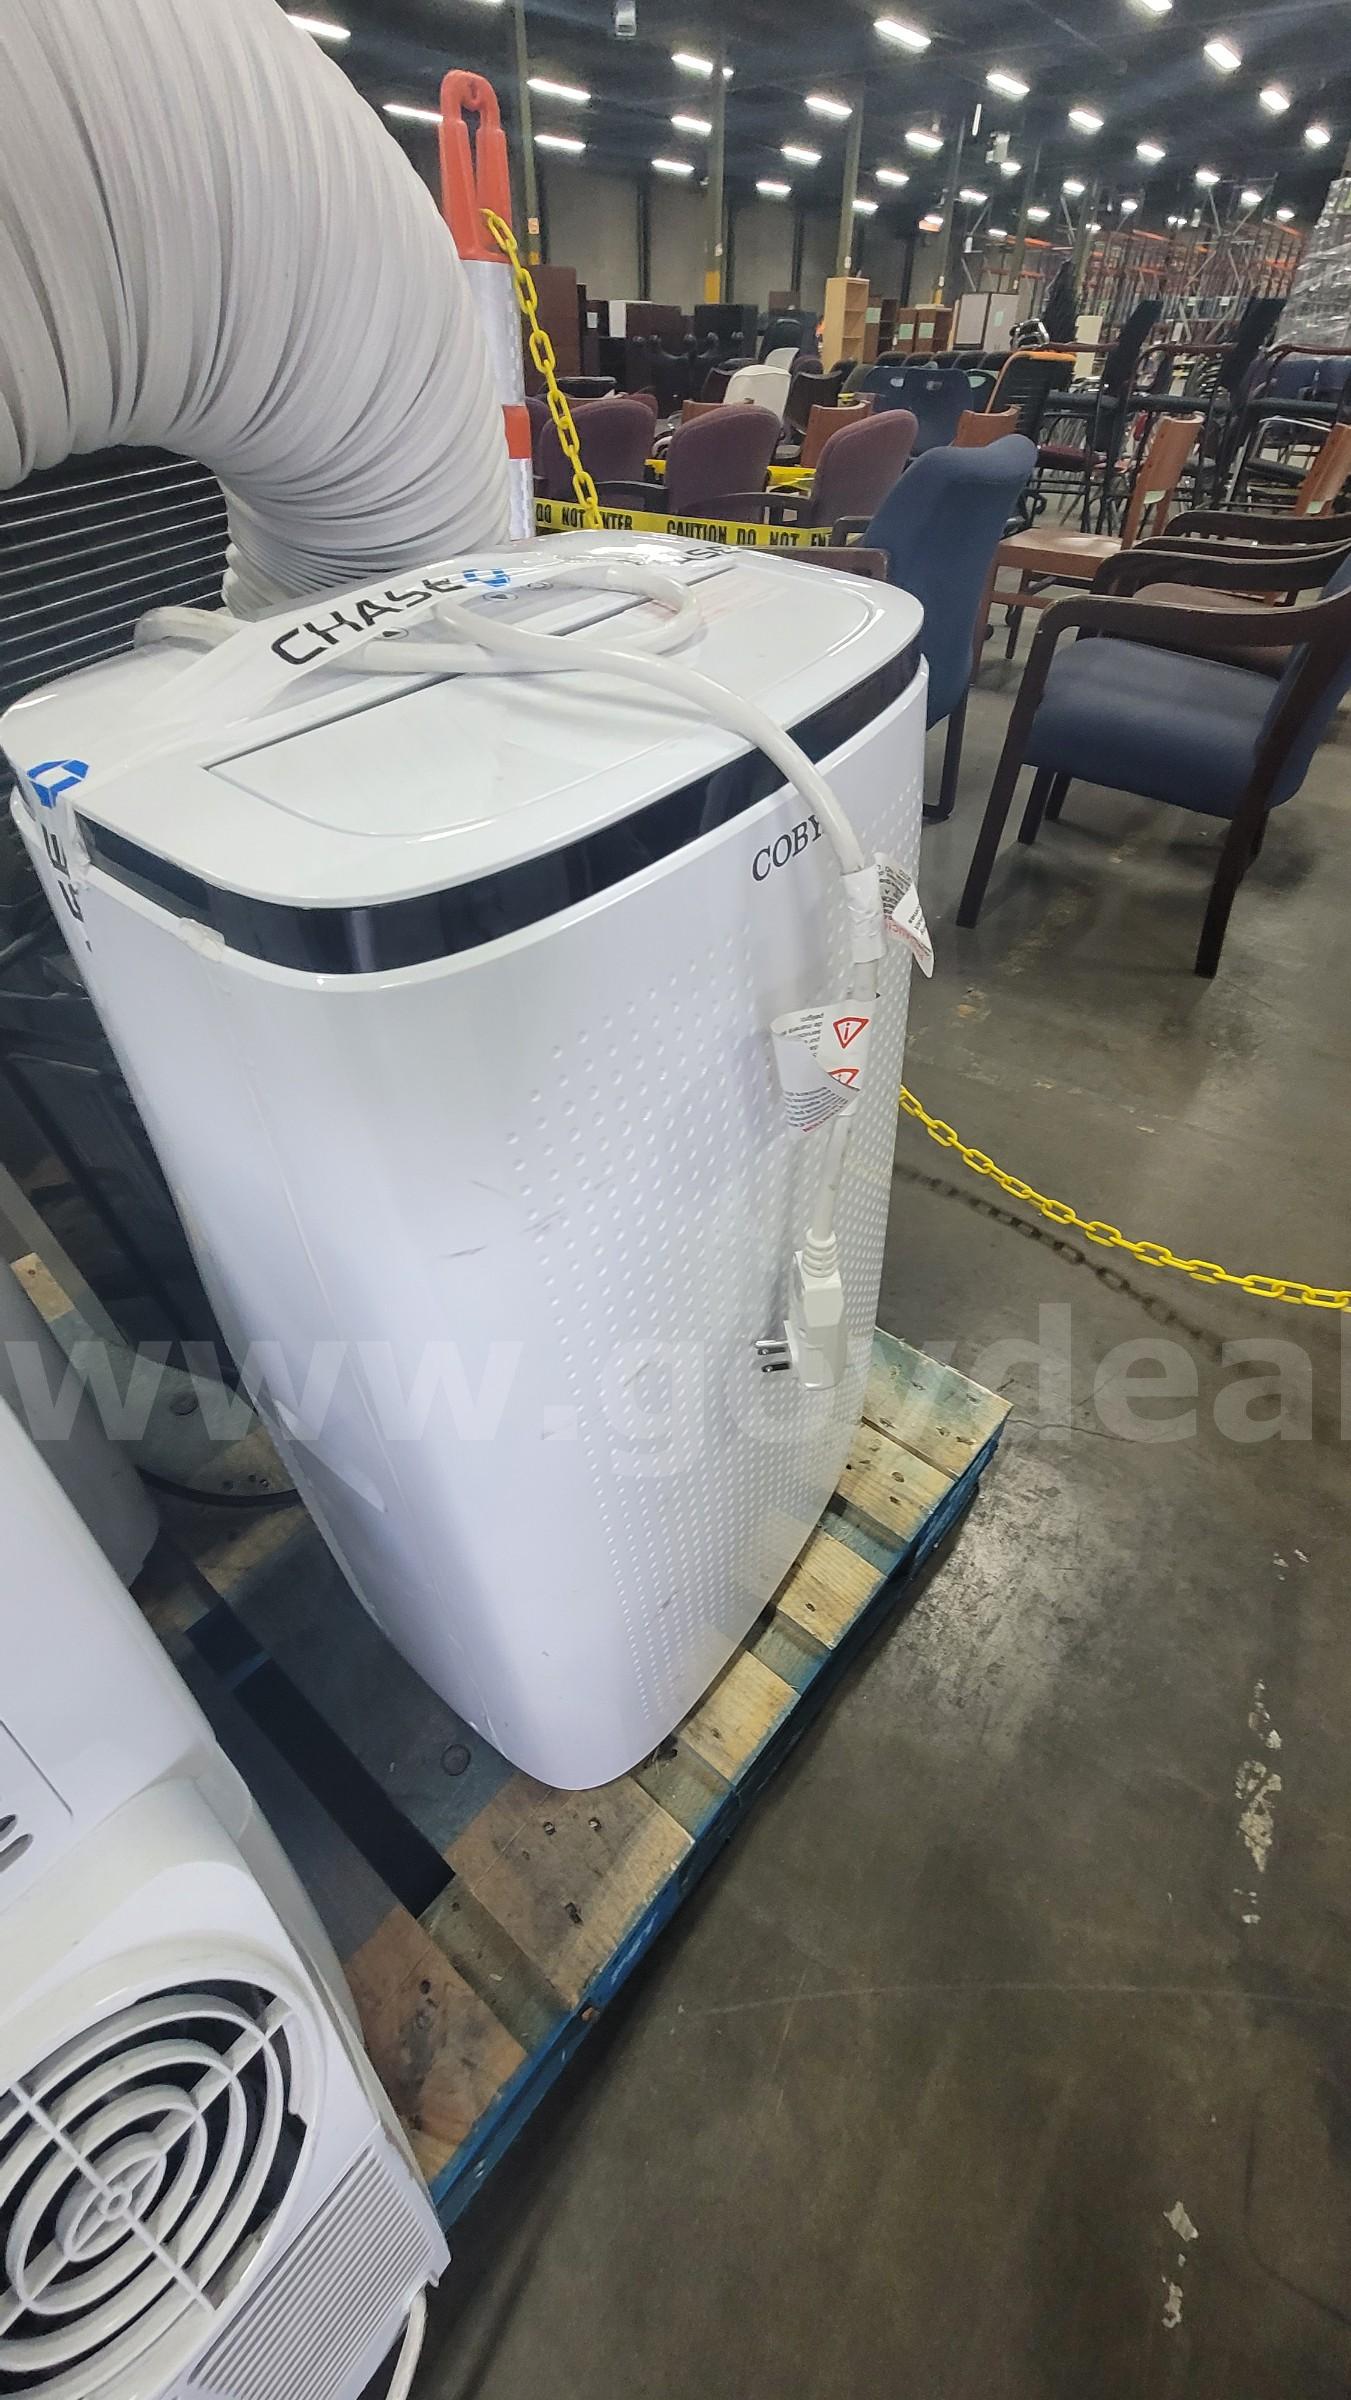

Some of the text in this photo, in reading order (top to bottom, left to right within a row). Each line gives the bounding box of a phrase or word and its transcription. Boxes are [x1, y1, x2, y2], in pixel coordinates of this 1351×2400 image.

[535, 503, 552, 524] DO
[561, 506, 586, 528] NOT
[600, 511, 633, 531] NTER
[666, 519, 727, 545] CAUTION
[736, 527, 757, 546] DO
[769, 531, 800, 547] NOT
[271, 578, 467, 665] CHASE
[752, 814, 822, 882] COBY
